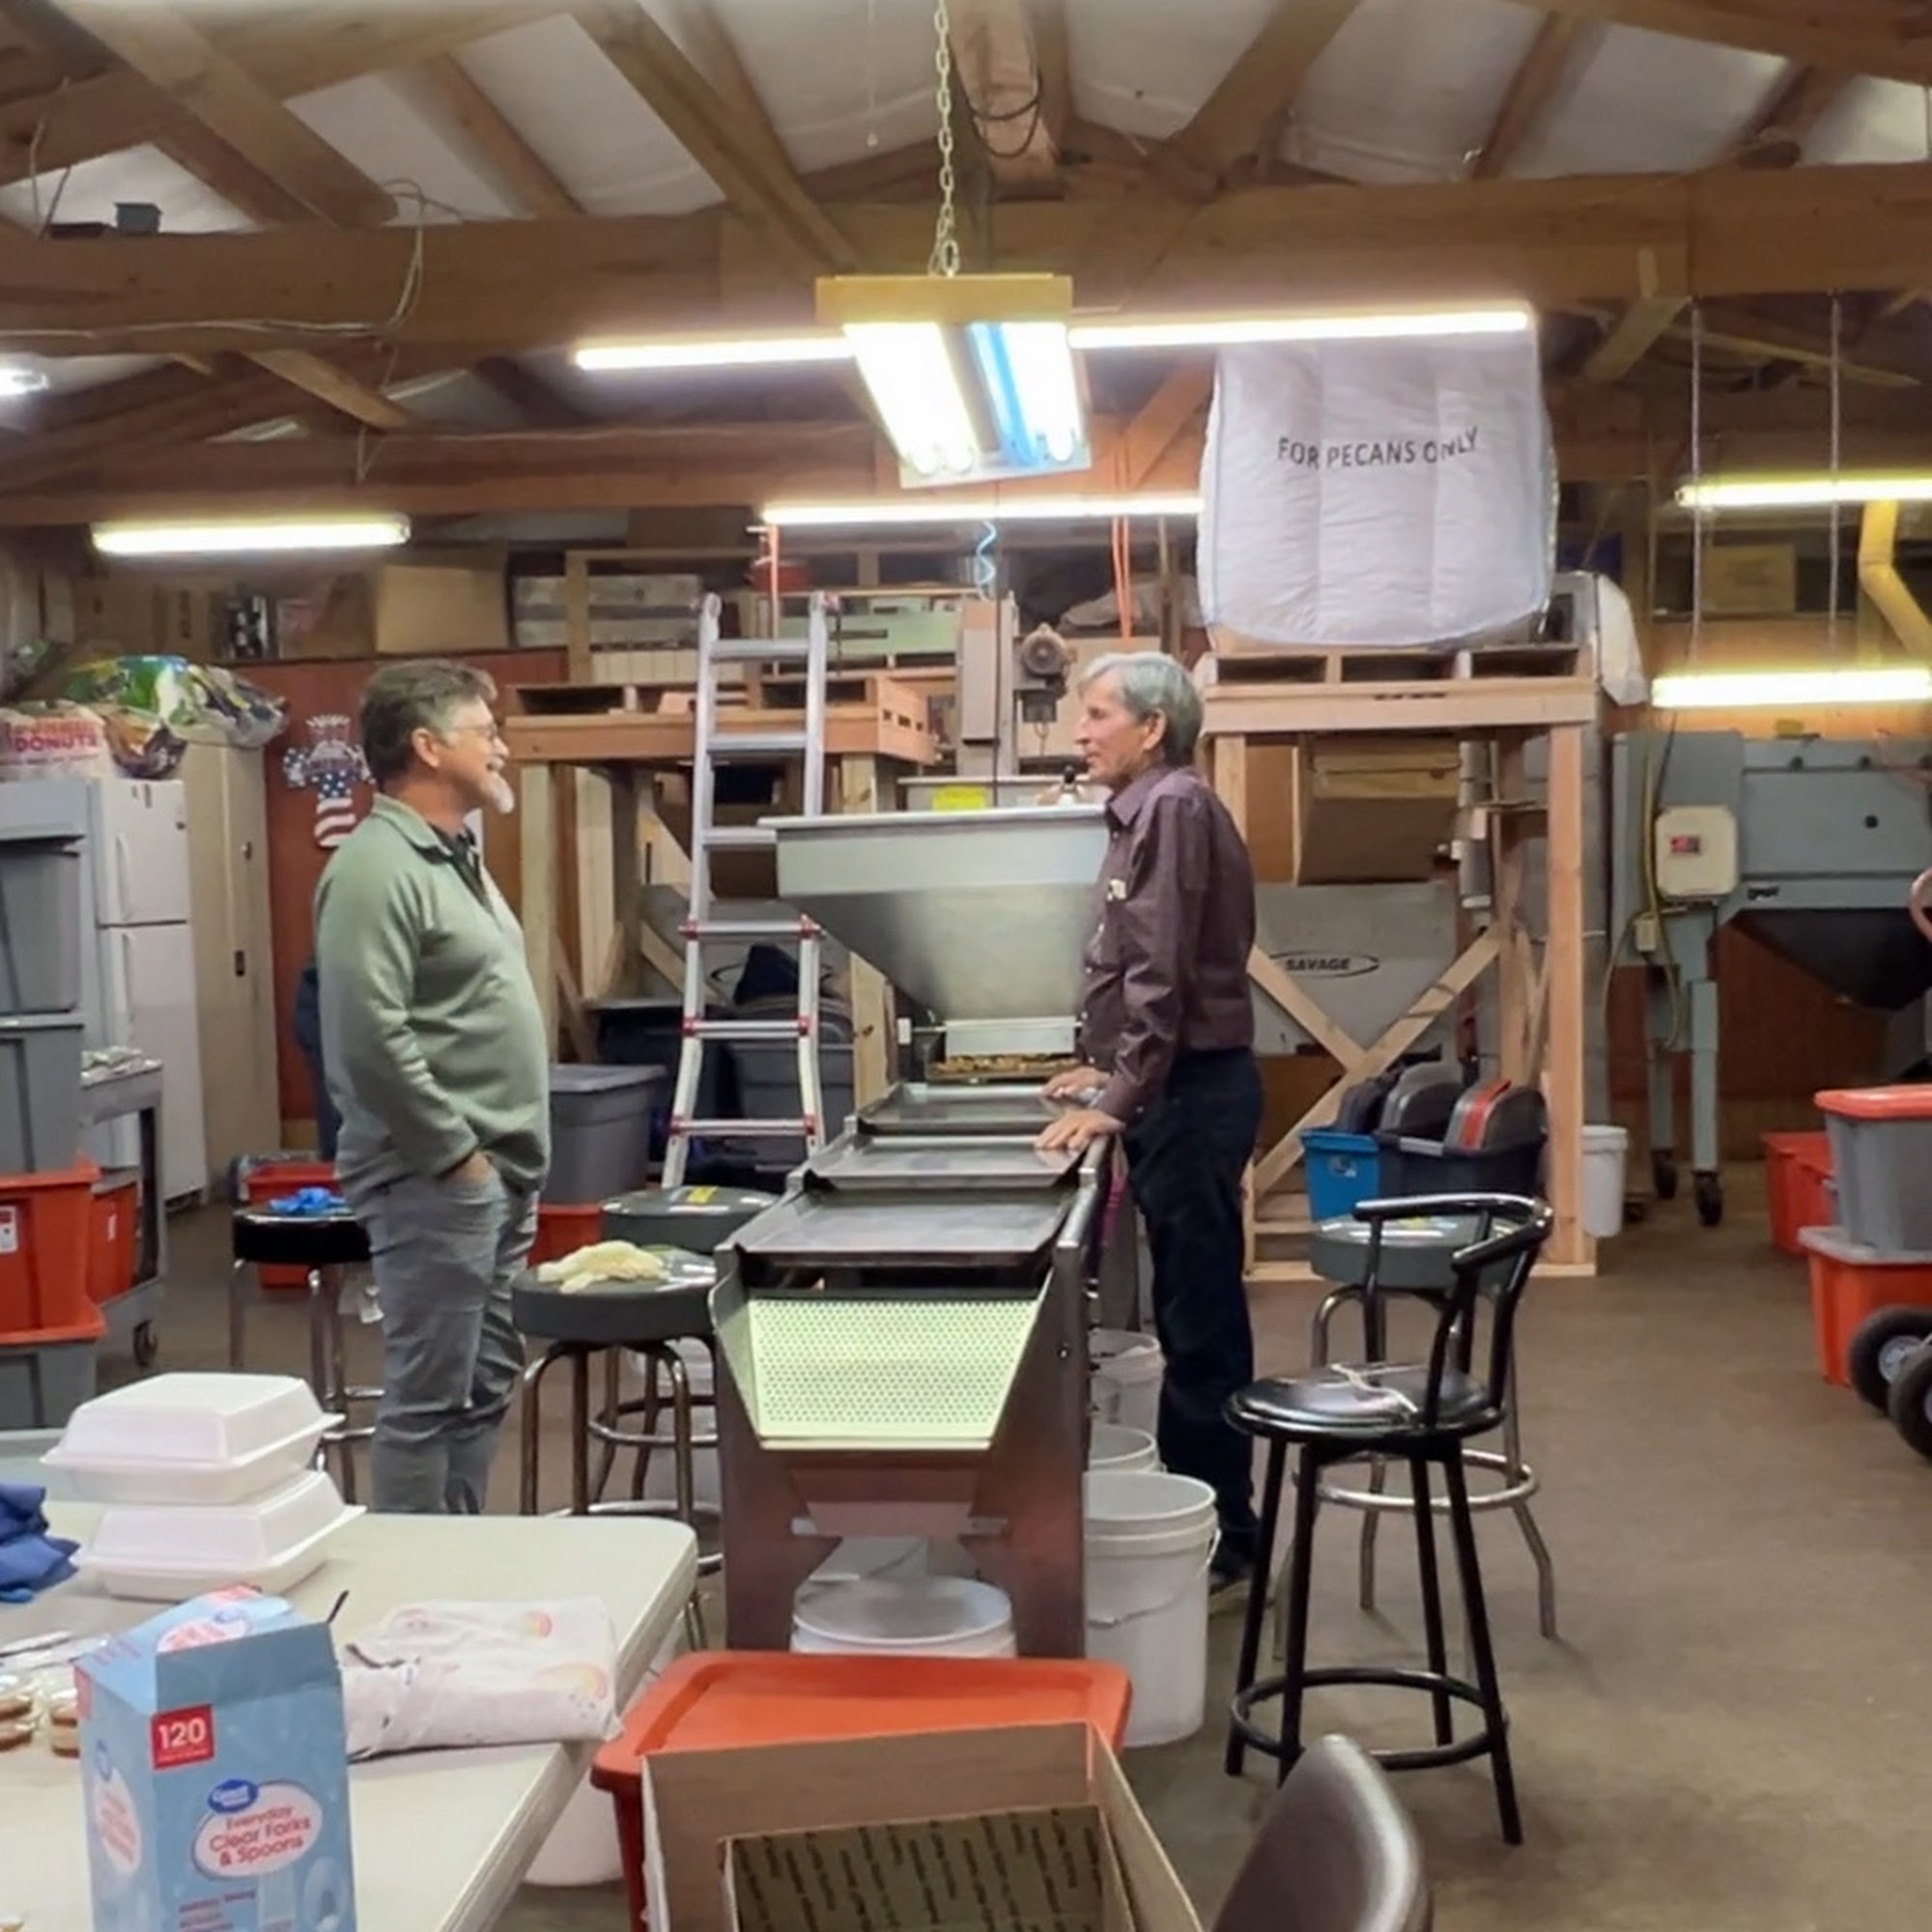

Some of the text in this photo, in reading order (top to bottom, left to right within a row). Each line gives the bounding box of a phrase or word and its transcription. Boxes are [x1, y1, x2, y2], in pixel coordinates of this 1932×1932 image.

[1278, 426, 1478, 469] FOR PECANS ONLY
[1285, 957, 1350, 972] SAVAGE
[158, 1717, 207, 1749] 120
[226, 1806, 293, 1831] Everyday
[210, 1816, 310, 1853] Clear Forks
[219, 1835, 303, 1866] & Spoons
